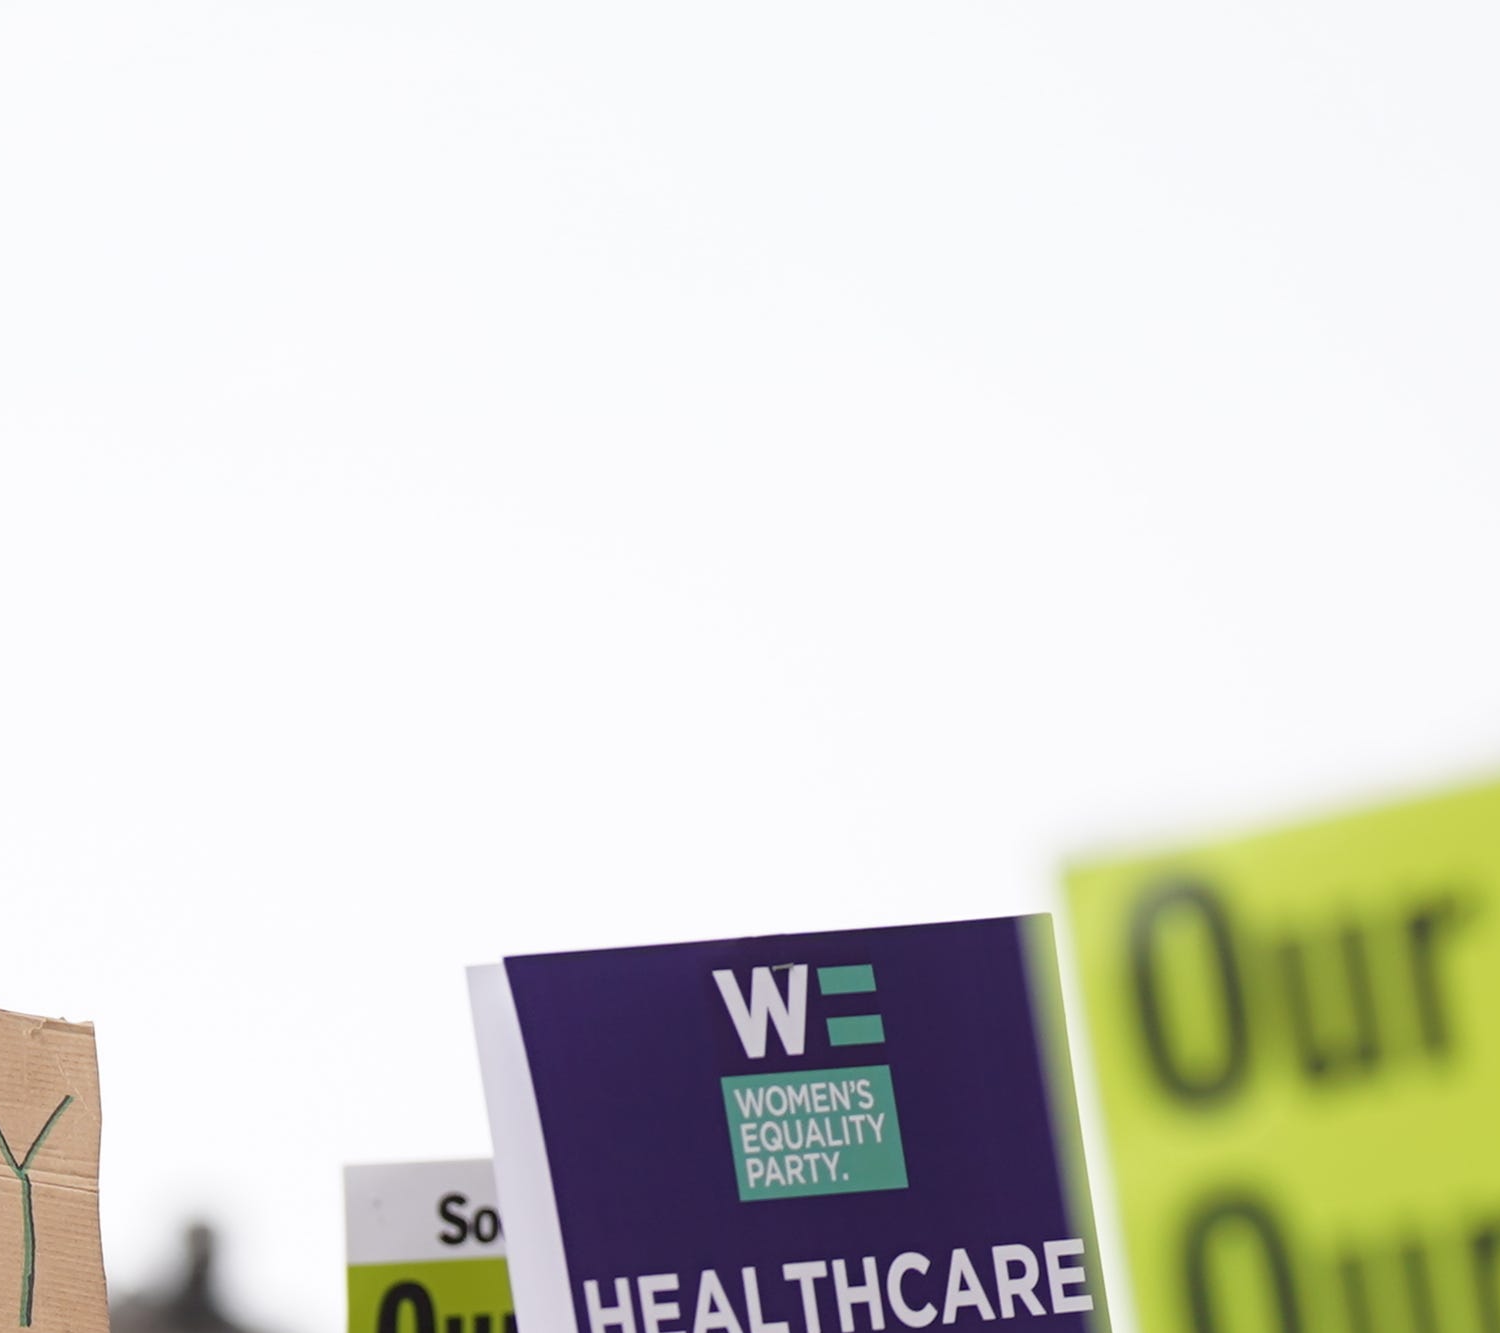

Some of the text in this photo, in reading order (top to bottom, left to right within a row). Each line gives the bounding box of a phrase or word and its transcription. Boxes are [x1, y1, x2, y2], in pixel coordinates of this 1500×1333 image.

[1123, 872, 1483, 1116] Our
[734, 1079, 875, 1119] WOMEN'S
[740, 1113, 885, 1153] EQUALITY
[745, 1152, 849, 1188] PARTY.
